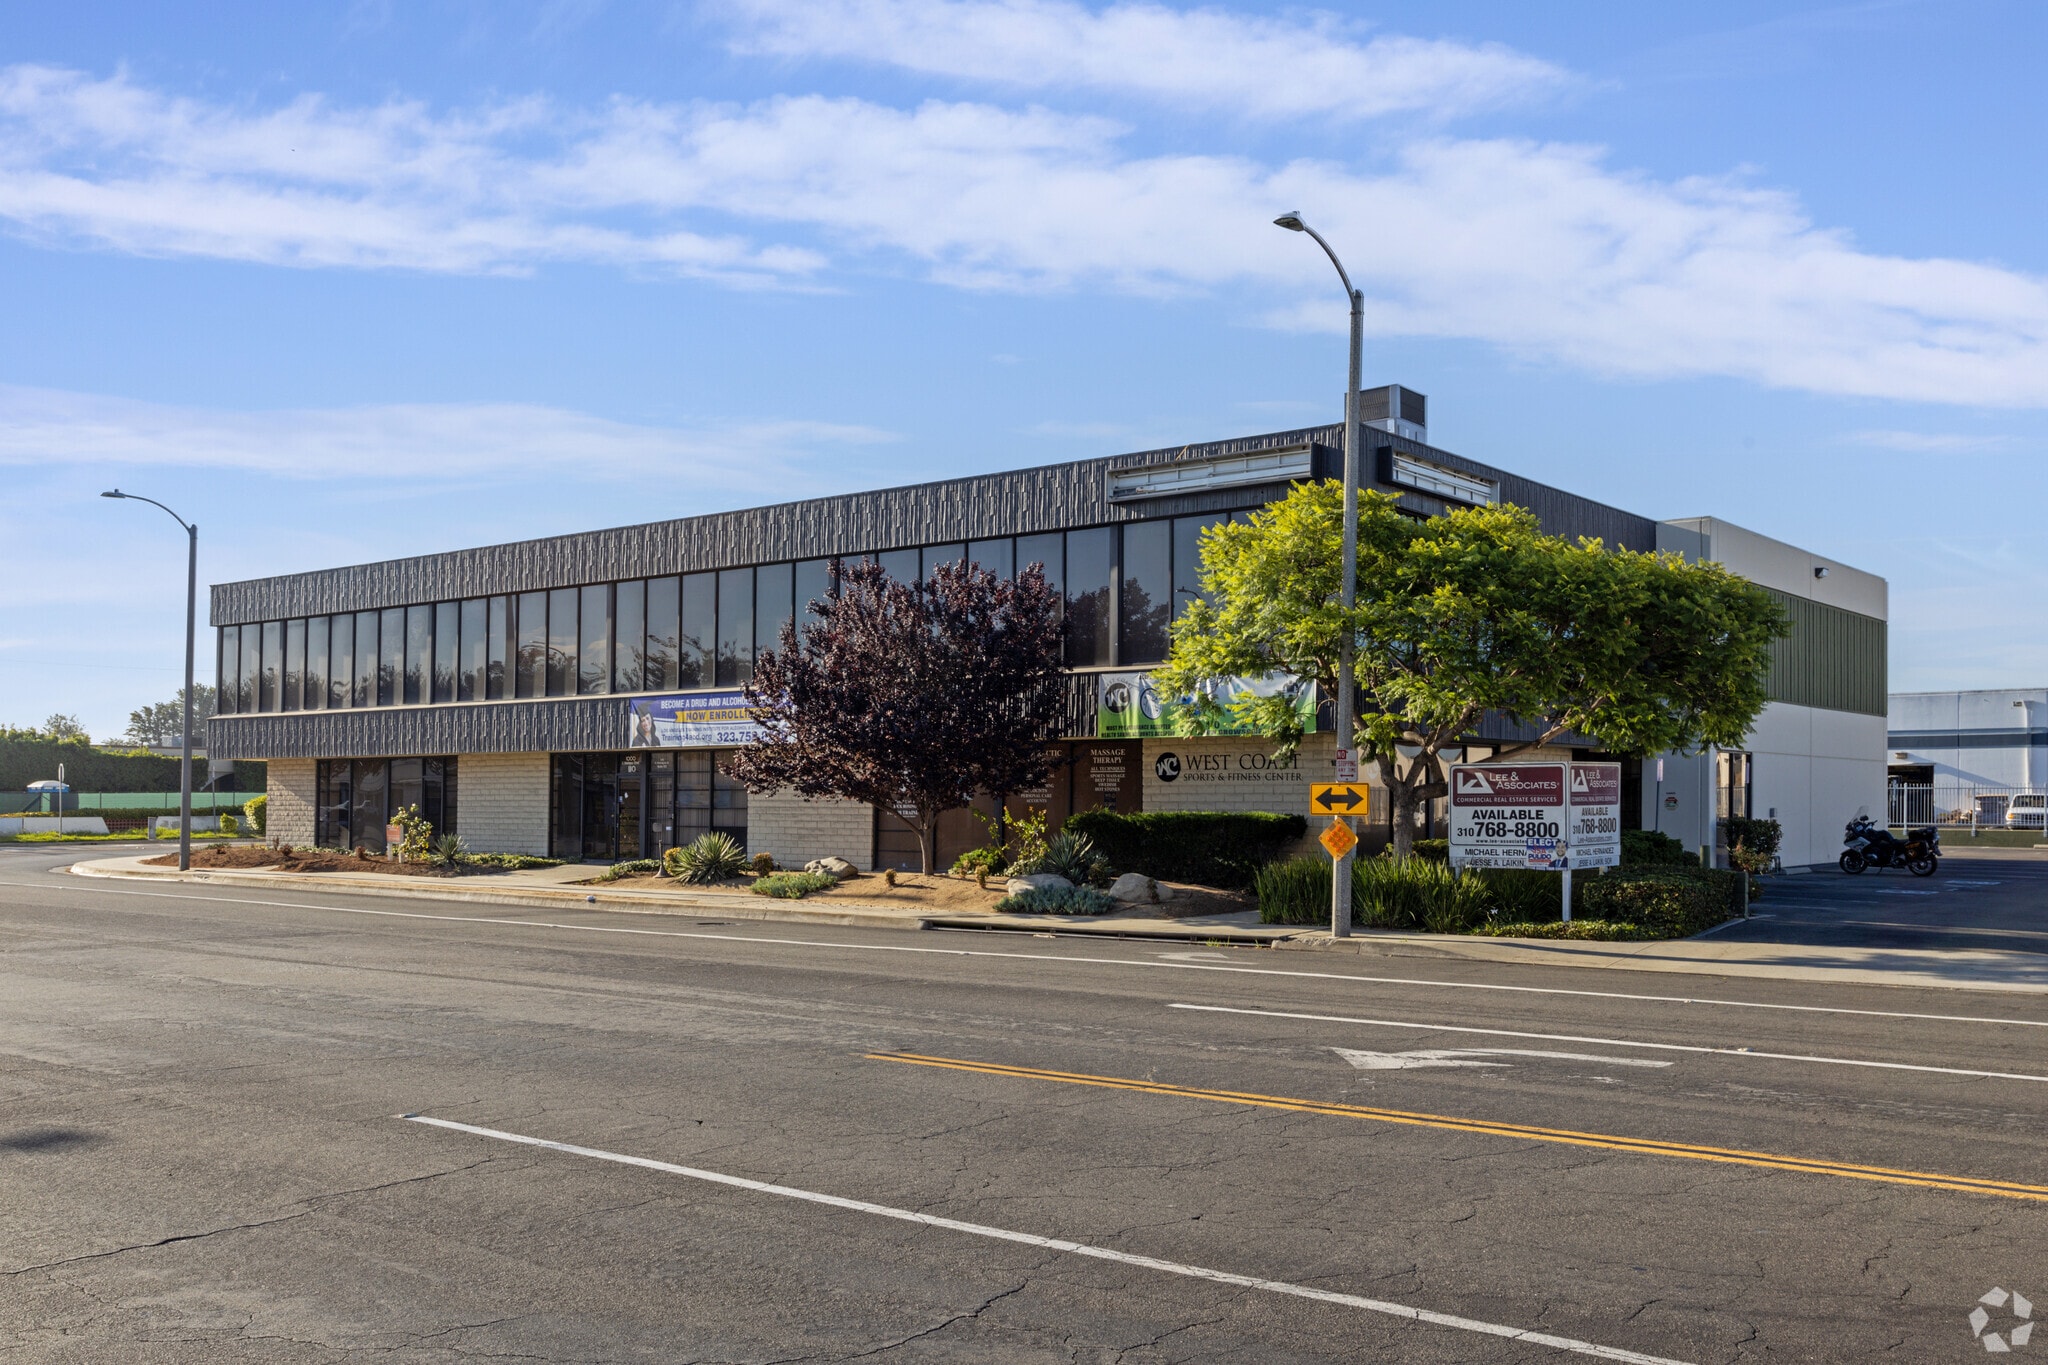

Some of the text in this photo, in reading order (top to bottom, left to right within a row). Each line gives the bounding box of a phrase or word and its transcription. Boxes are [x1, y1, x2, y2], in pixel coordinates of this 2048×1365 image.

[660, 699, 685, 709] BECOME
[686, 699, 690, 708] A
[691, 698, 708, 707] DRUG
[708, 697, 721, 706] AND
[686, 711, 706, 721] NOW
[1337, 750, 1346, 759] NO
[1093, 756, 1122, 764] THERAPY
[1185, 753, 1302, 771] WEST COAT
[1183, 772, 1302, 781] SPORTS & FITNESS CENTER
[1510, 771, 1519, 781] &
[1496, 780, 1557, 790] ASSOCIATES
[1589, 780, 1617, 788] ASSOCIATES
[1471, 809, 1544, 820] AVAILABLE
[1582, 807, 1608, 816] AVAILABLE
[1457, 822, 1559, 838] 310 768-8800
[1573, 817, 1617, 834] 310 768-8800
[1527, 838, 1558, 846] ELECT
[1465, 848, 1527, 857] MICHAEL HERN
[1576, 846, 1614, 856] MICHAEL HERNANDEZ
[1493, 859, 1500, 867] A.
